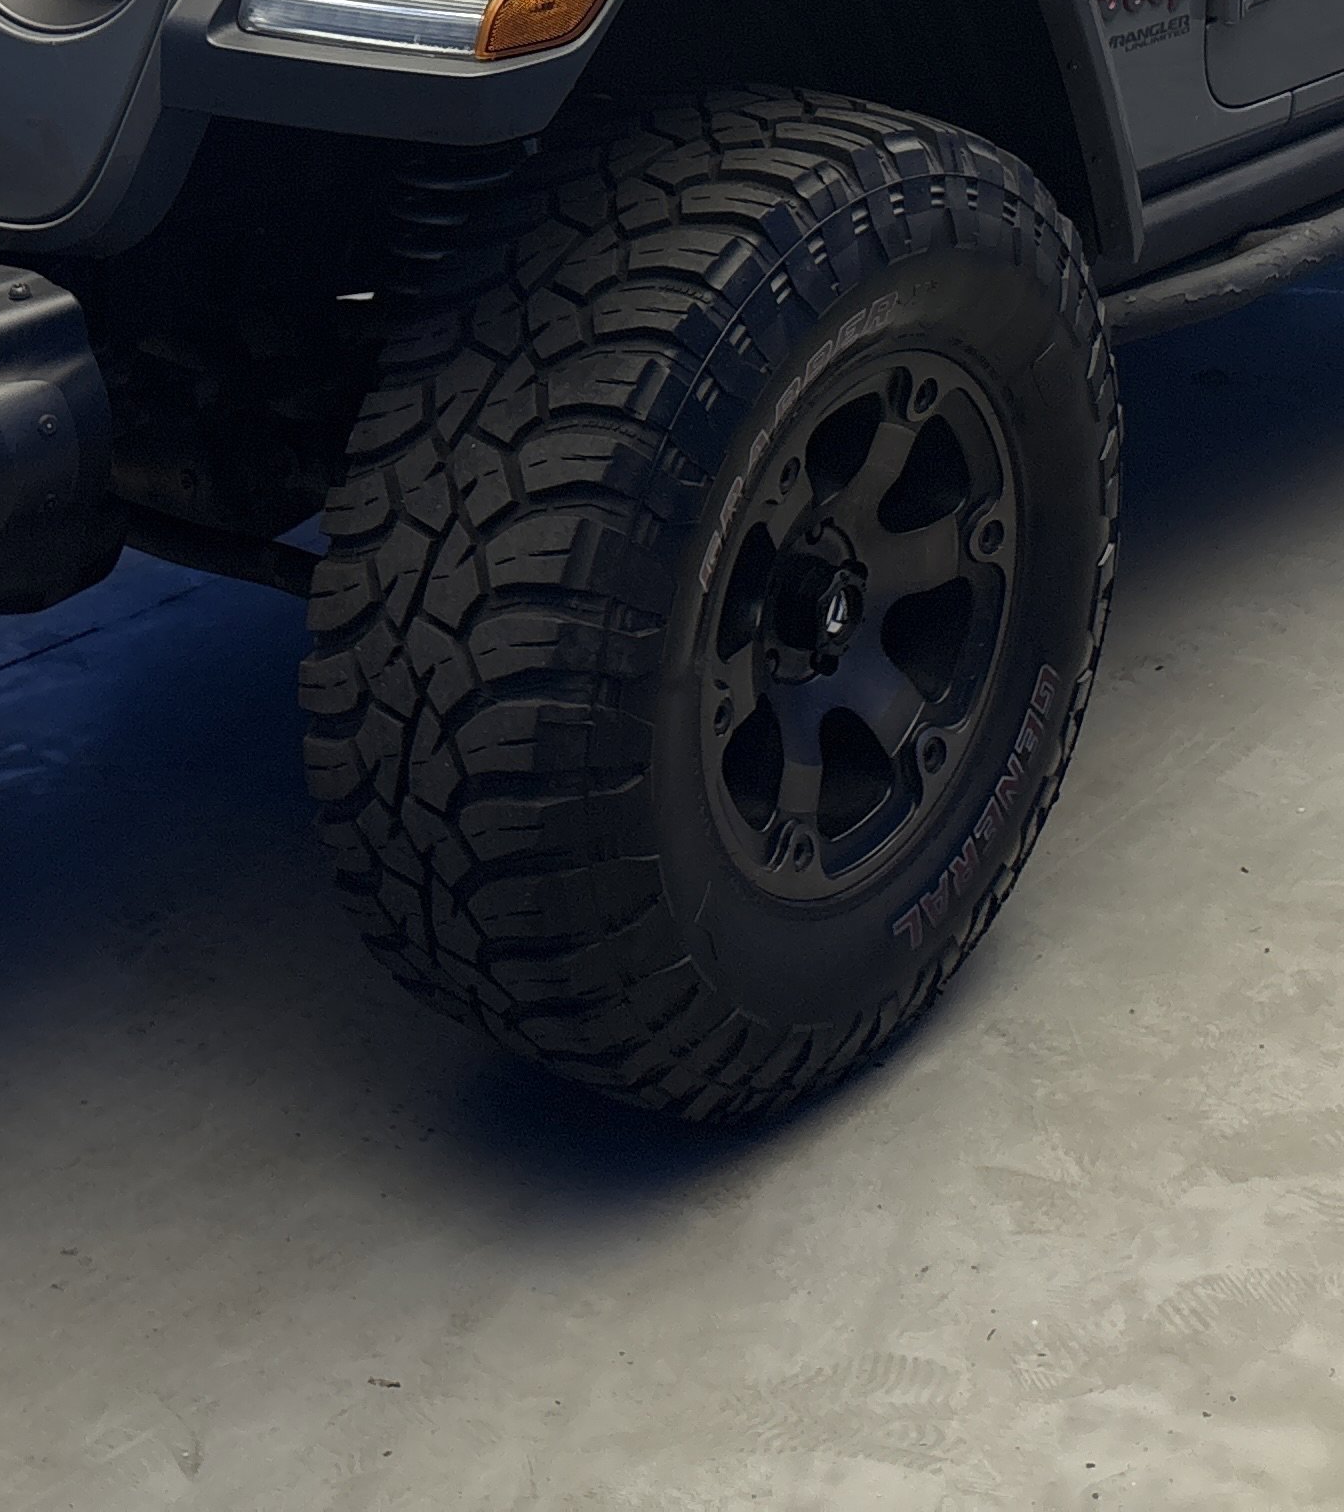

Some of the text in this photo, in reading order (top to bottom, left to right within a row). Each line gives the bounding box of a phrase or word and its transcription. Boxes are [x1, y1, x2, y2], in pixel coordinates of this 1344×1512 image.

[1124, 26, 1191, 53] UNLIMITED
[698, 291, 899, 593] GRABBER
[891, 663, 1060, 951] GENERAL
